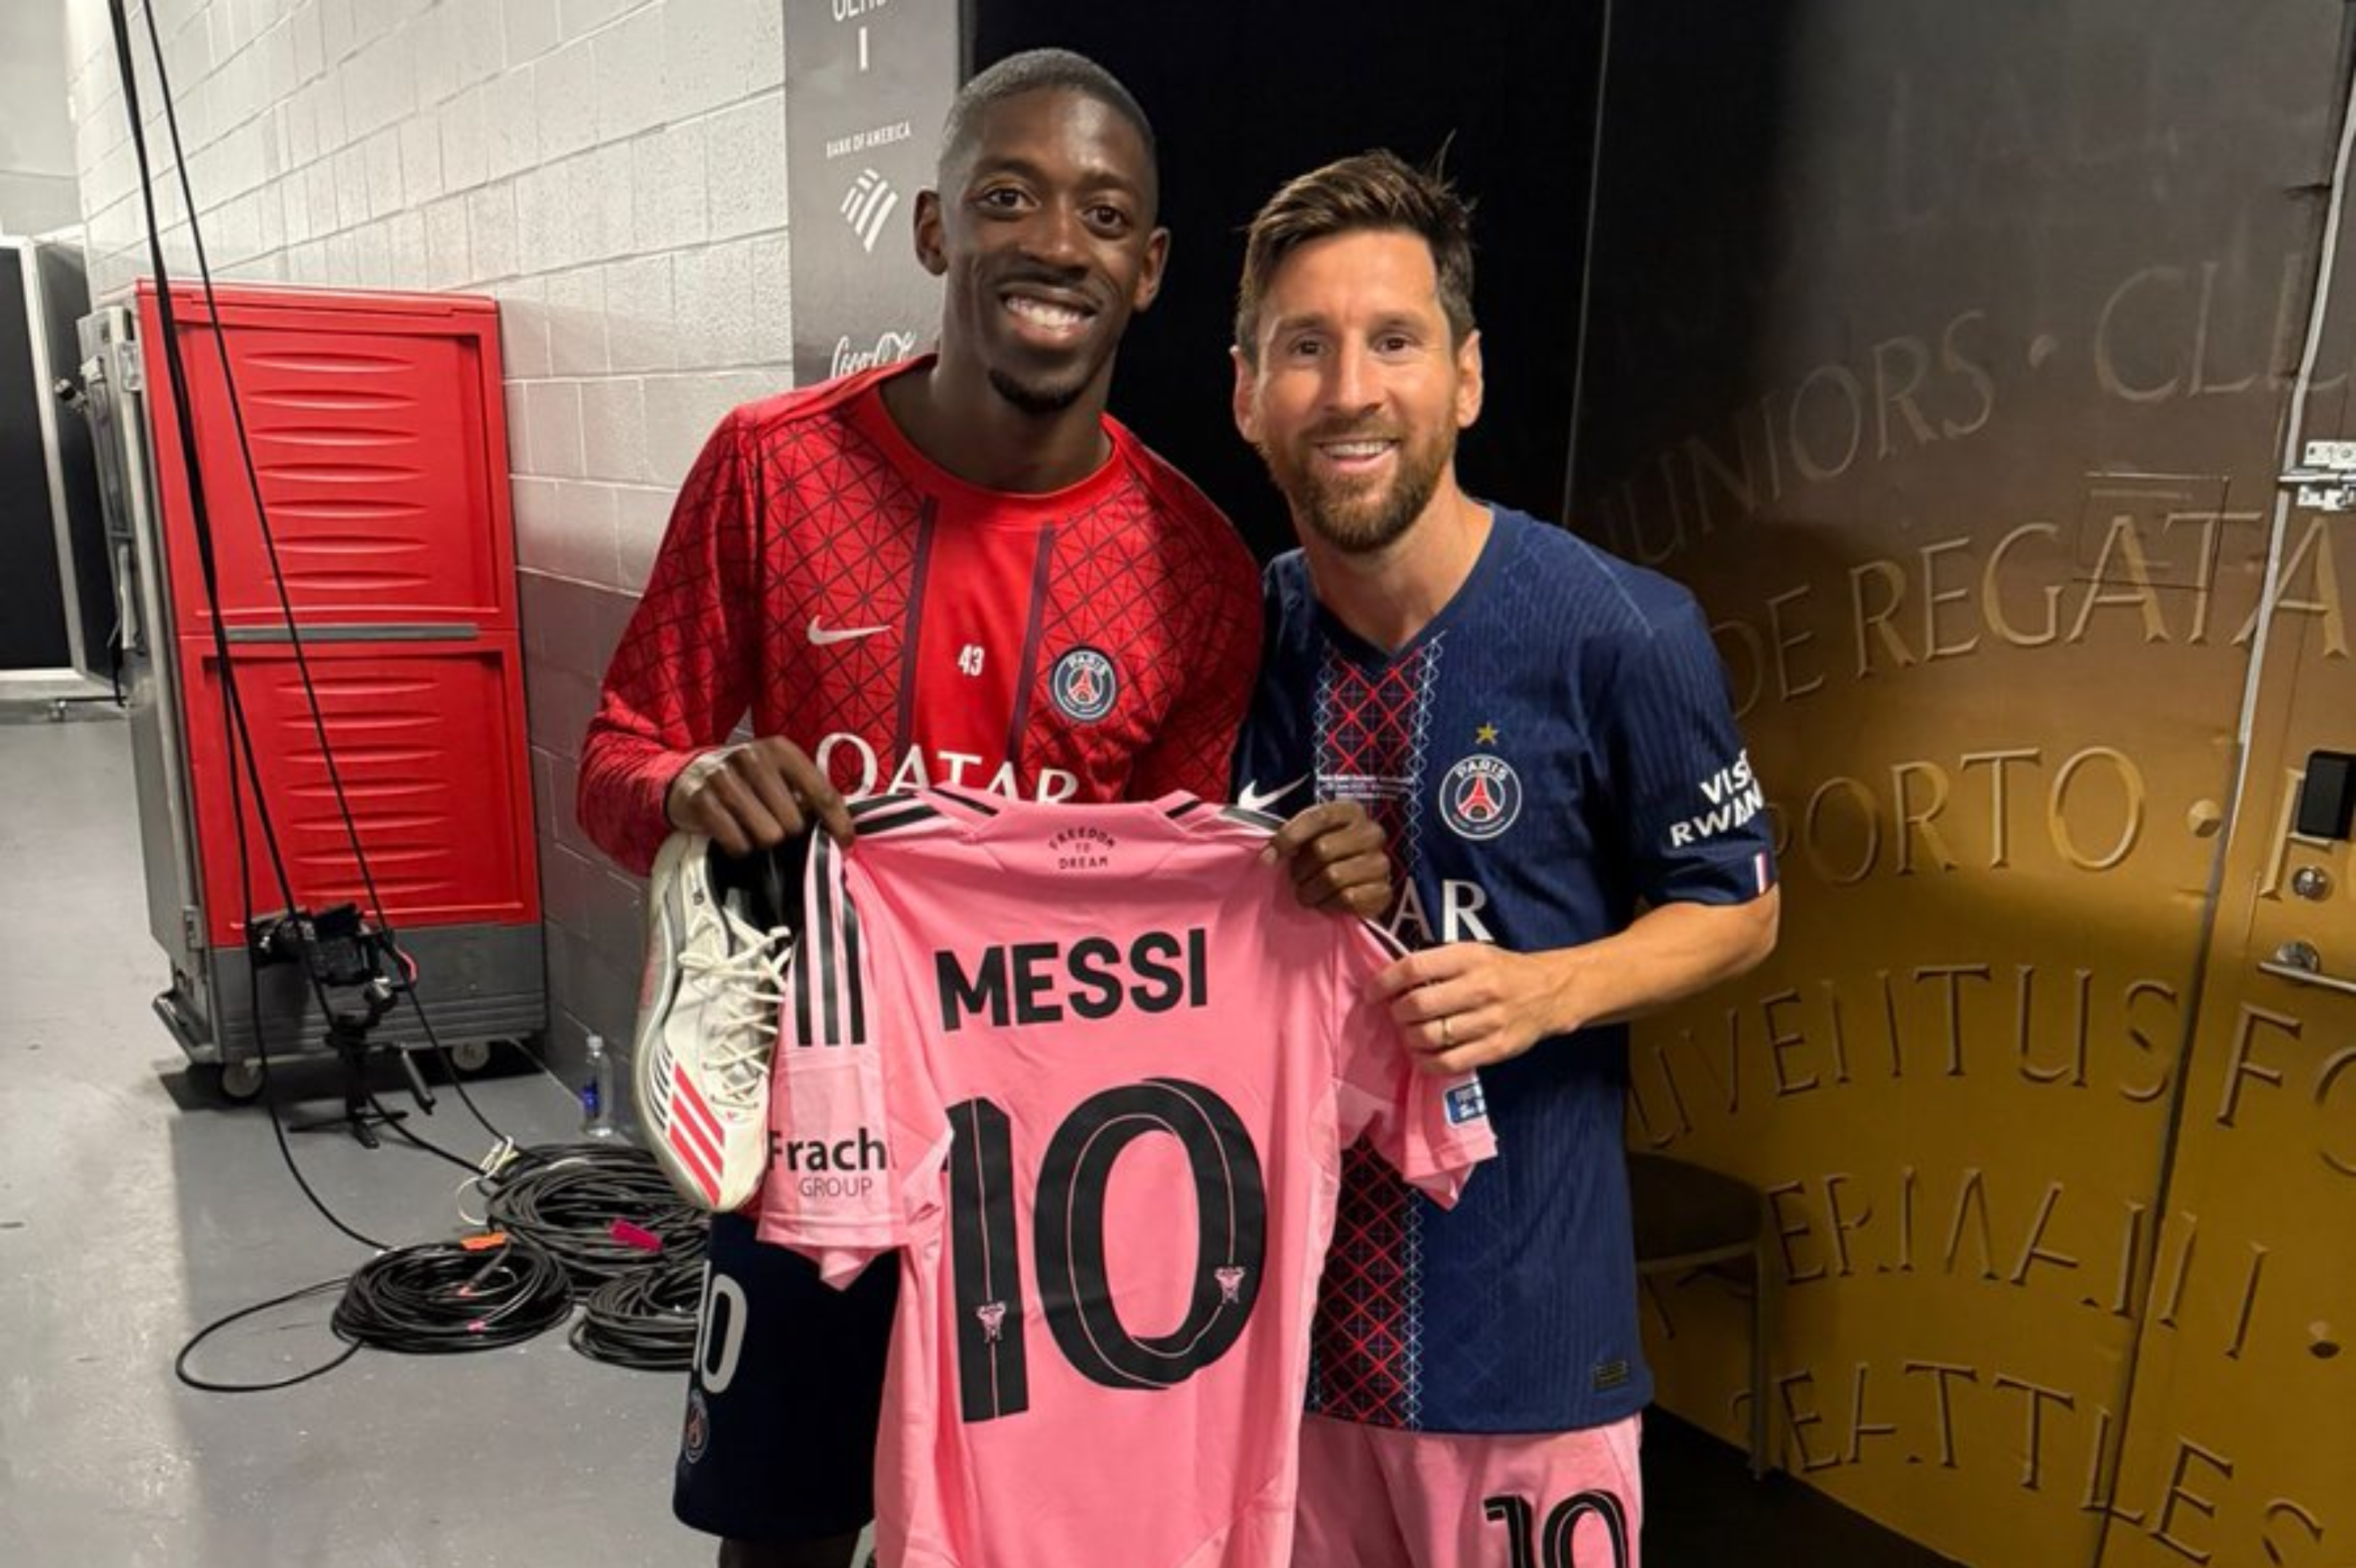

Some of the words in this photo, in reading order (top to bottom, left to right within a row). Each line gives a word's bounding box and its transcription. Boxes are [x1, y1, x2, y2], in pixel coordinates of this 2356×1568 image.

[866, 120, 911, 148] AMERICA
[958, 643, 985, 677] 43
[816, 732, 1080, 804] QATAR
[1454, 759, 1508, 780] PARIS
[1049, 826, 1116, 851] FREEDOM
[1076, 842, 1090, 854] TO
[1057, 856, 1109, 871] DREAM
[934, 927, 1208, 1033] MESSI
[799, 1177, 874, 1198] GROUP
[941, 1077, 1267, 1424] 10
